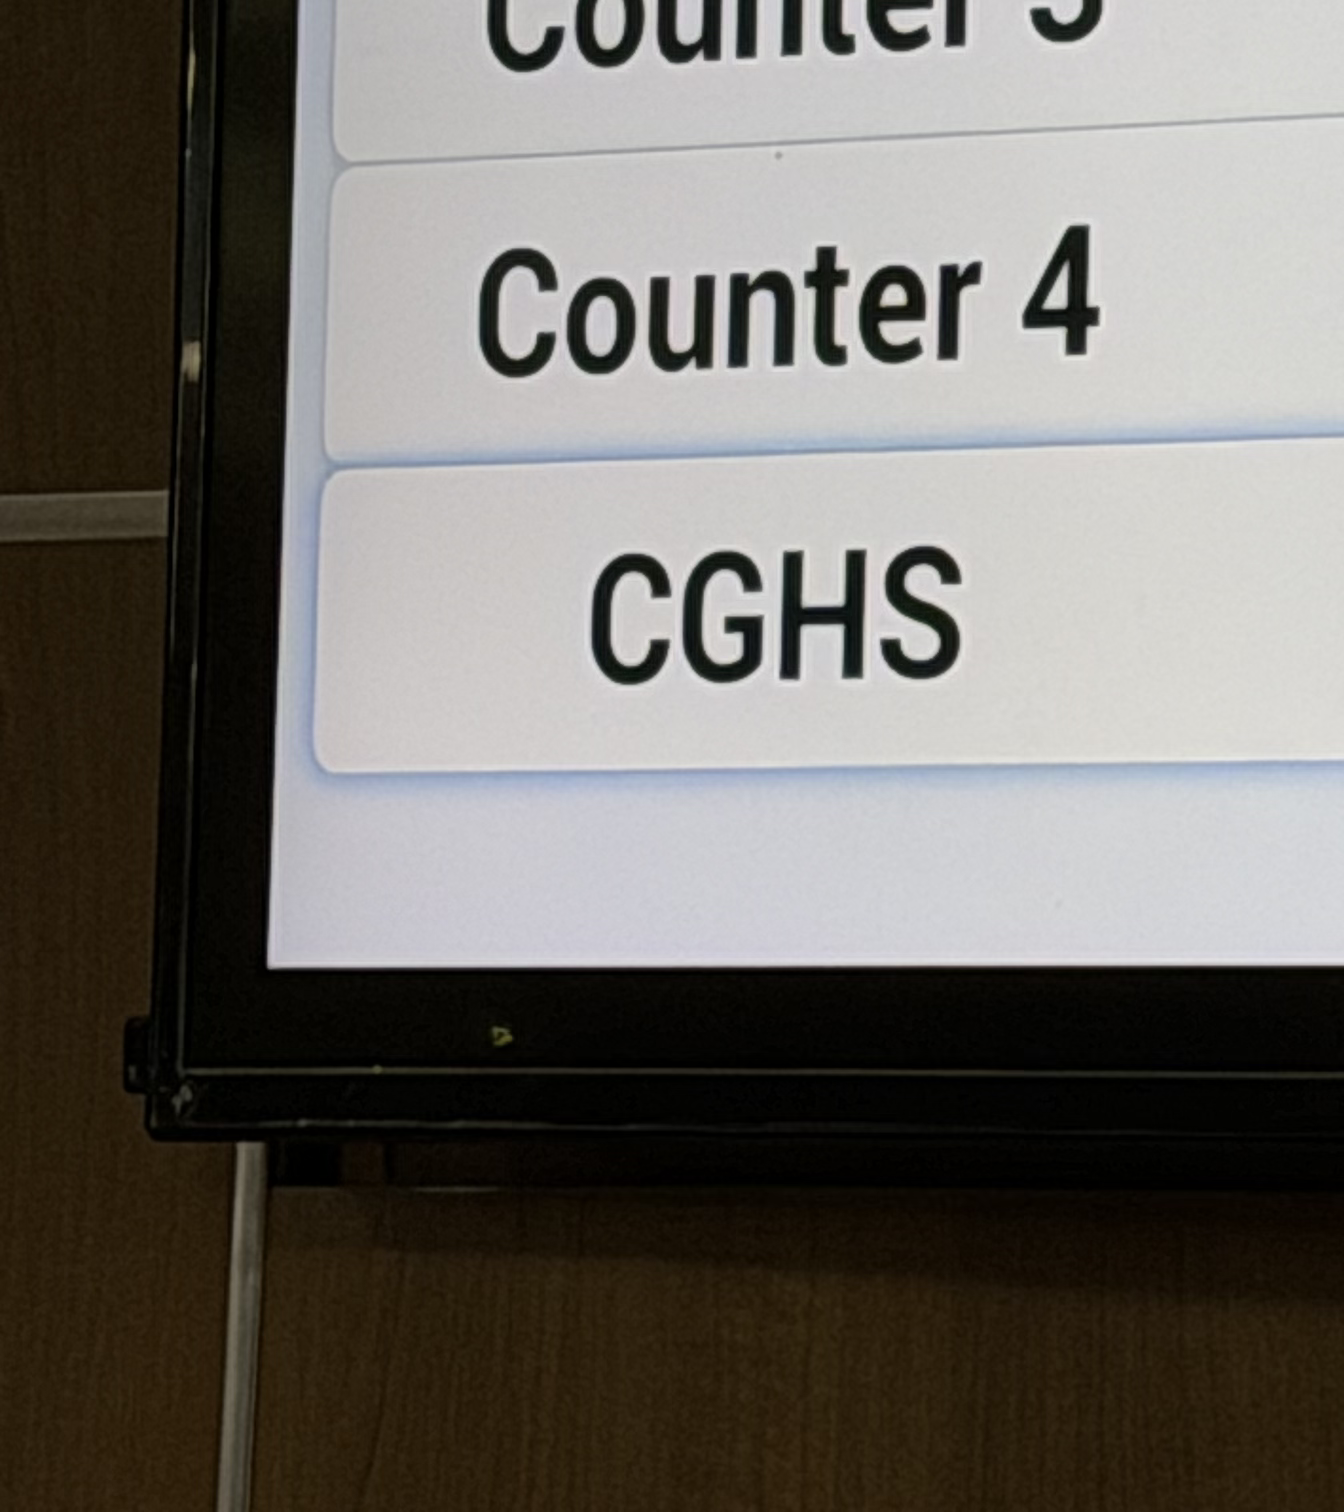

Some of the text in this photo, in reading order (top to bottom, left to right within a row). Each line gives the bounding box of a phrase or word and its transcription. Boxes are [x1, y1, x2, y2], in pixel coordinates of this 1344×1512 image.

[478, 225, 1100, 379] Counter 4
[591, 545, 962, 686] CGHS
